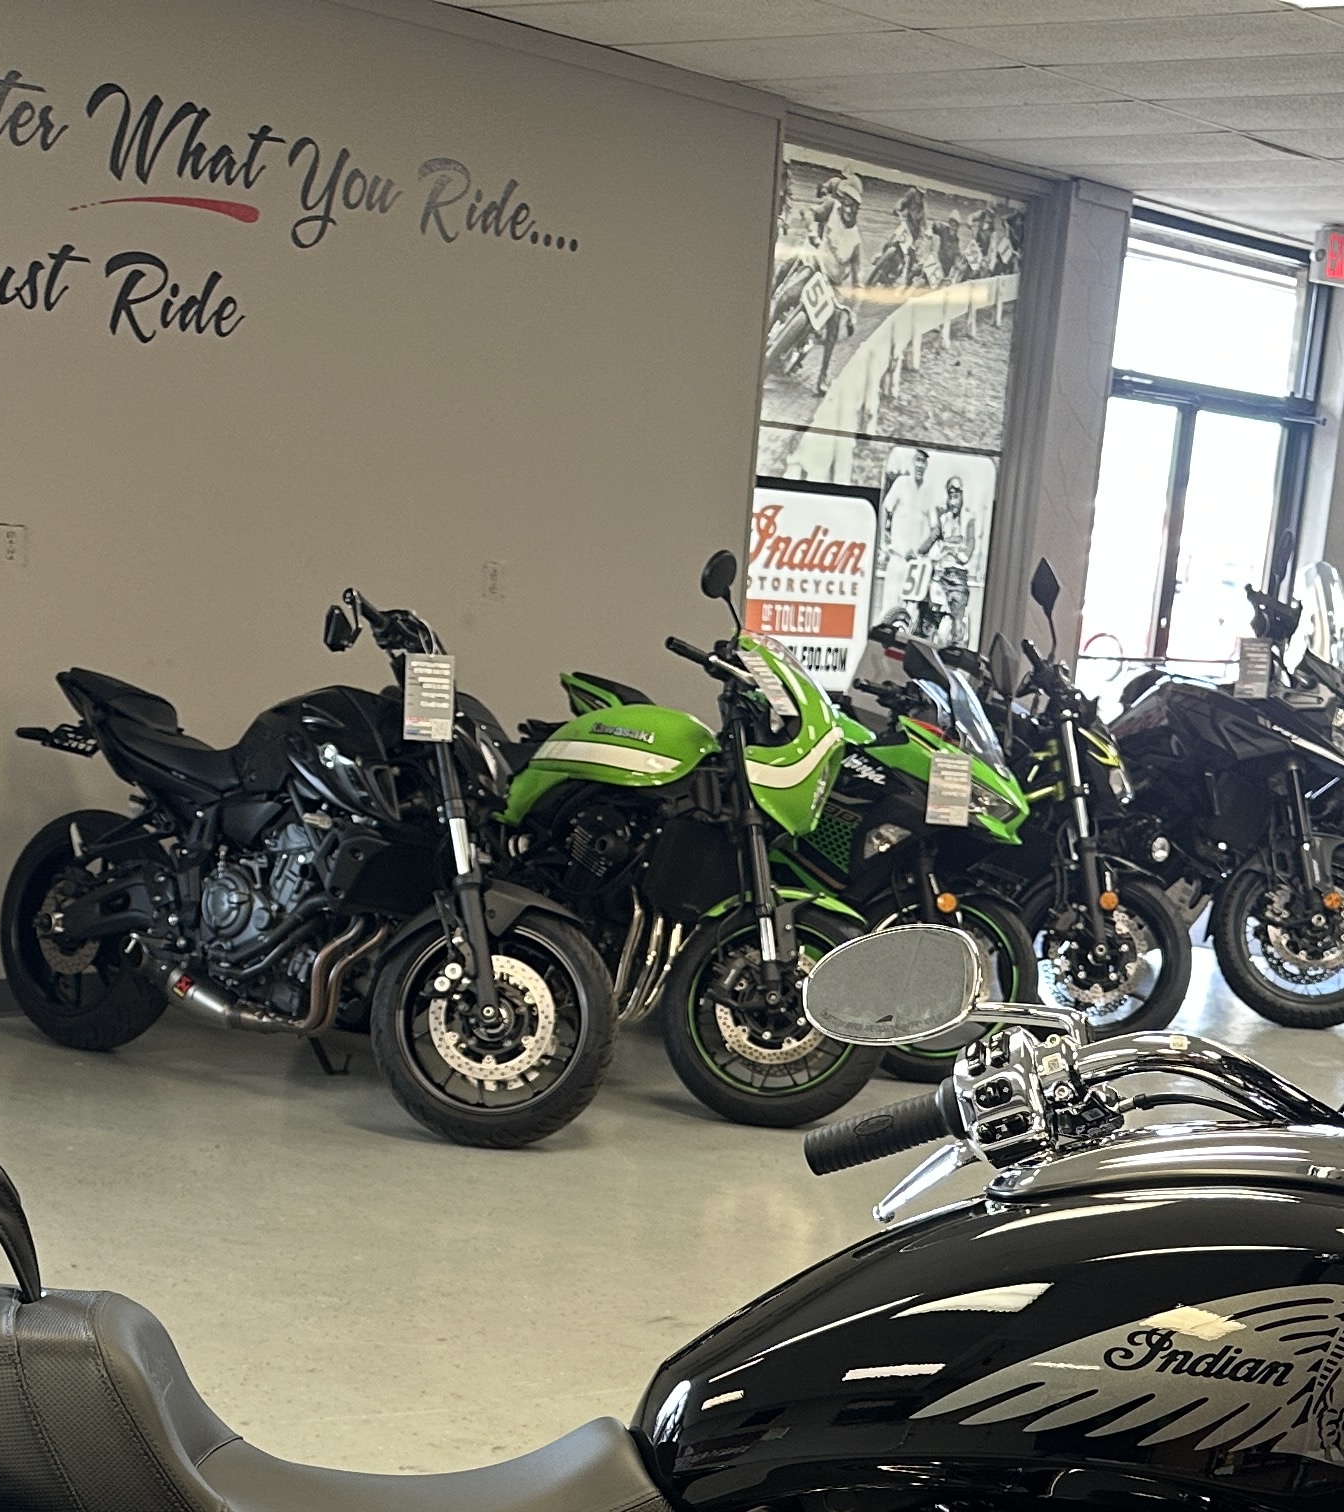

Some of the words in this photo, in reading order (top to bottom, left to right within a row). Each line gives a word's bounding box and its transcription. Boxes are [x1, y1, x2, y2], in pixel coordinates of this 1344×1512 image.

[85, 82, 285, 190] What
[287, 136, 402, 249] You
[105, 251, 245, 343] Ride
[750, 504, 866, 576] Indian
[902, 563, 926, 596] 51
[774, 604, 822, 633] TOLEDO
[840, 753, 887, 786] Ninja
[1104, 1326, 1292, 1388] Indian
